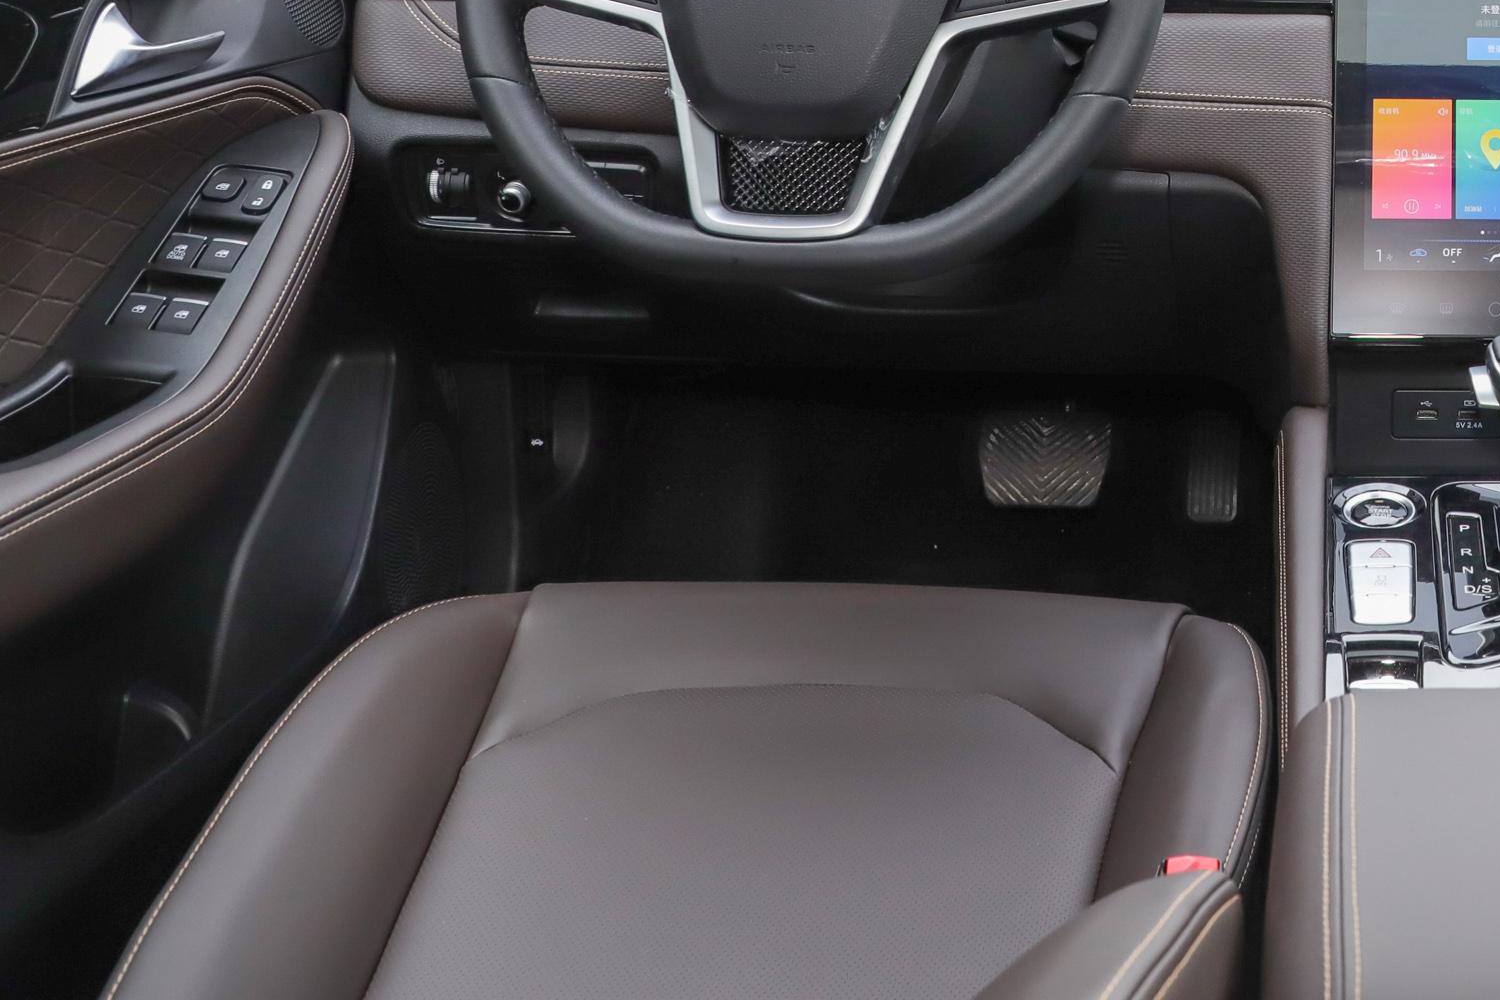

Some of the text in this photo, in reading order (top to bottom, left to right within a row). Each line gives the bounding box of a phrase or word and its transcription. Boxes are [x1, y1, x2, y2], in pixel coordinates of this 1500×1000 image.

[1442, 247, 1463, 257] OFF
[1467, 421, 1483, 429] 2.4A
[1459, 524, 1470, 533] P
[1460, 548, 1473, 557] R
[1462, 565, 1474, 574] N
[1463, 584, 1493, 594] D/S
